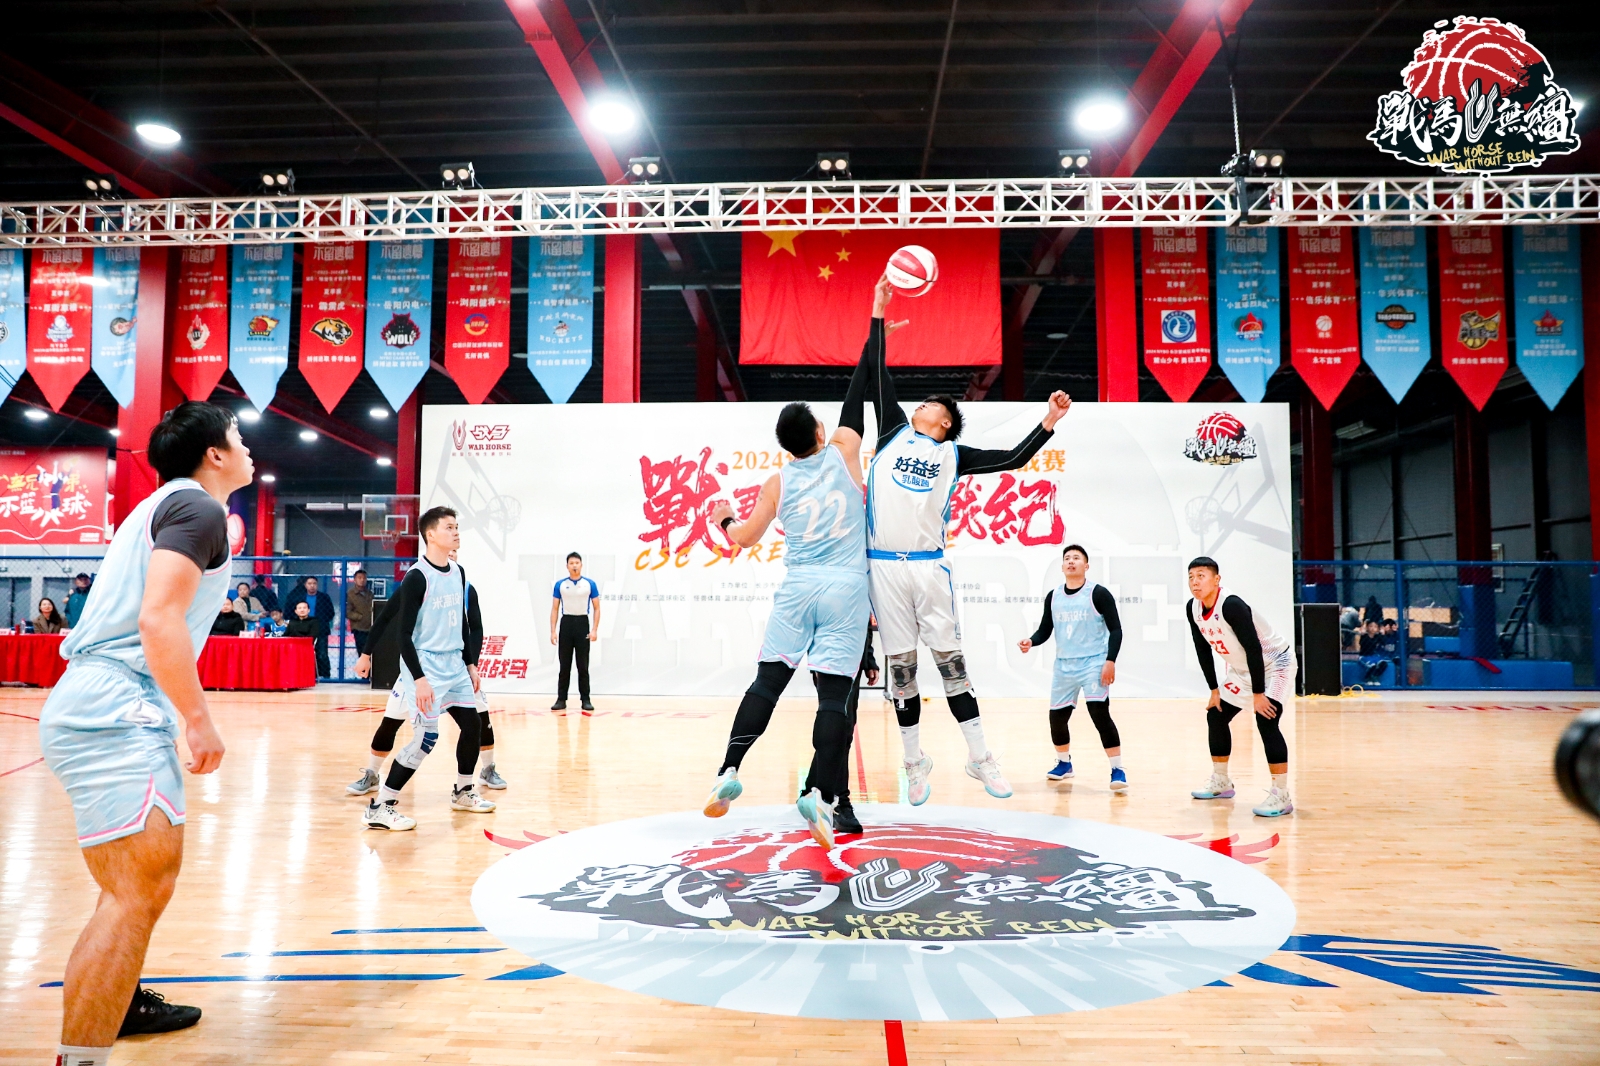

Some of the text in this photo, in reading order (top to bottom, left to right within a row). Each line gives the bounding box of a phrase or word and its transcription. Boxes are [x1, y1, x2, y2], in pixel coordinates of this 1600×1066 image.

[381, 244, 423, 259] 不留遗憾
[459, 241, 500, 257] 不留遗憾
[541, 241, 584, 256] 不留遗憾
[1153, 238, 1197, 253] 不留遗憾
[313, 246, 354, 261] 不留遗憾
[383, 301, 421, 309] 岳阳闪电
[460, 298, 496, 307] 浏阳健将
[540, 334, 583, 344] ROCKETS
[892, 456, 941, 479] 好益多
[902, 474, 931, 488] 乳酸菌
[797, 489, 850, 543] 22
[634, 549, 693, 571] CSC
[447, 609, 458, 628] 13
[1066, 624, 1074, 640] 9
[1091, 682, 1098, 694] 9
[708, 910, 997, 931] WAR HORSE
[809, 917, 1117, 941] WITHOUT REIN
